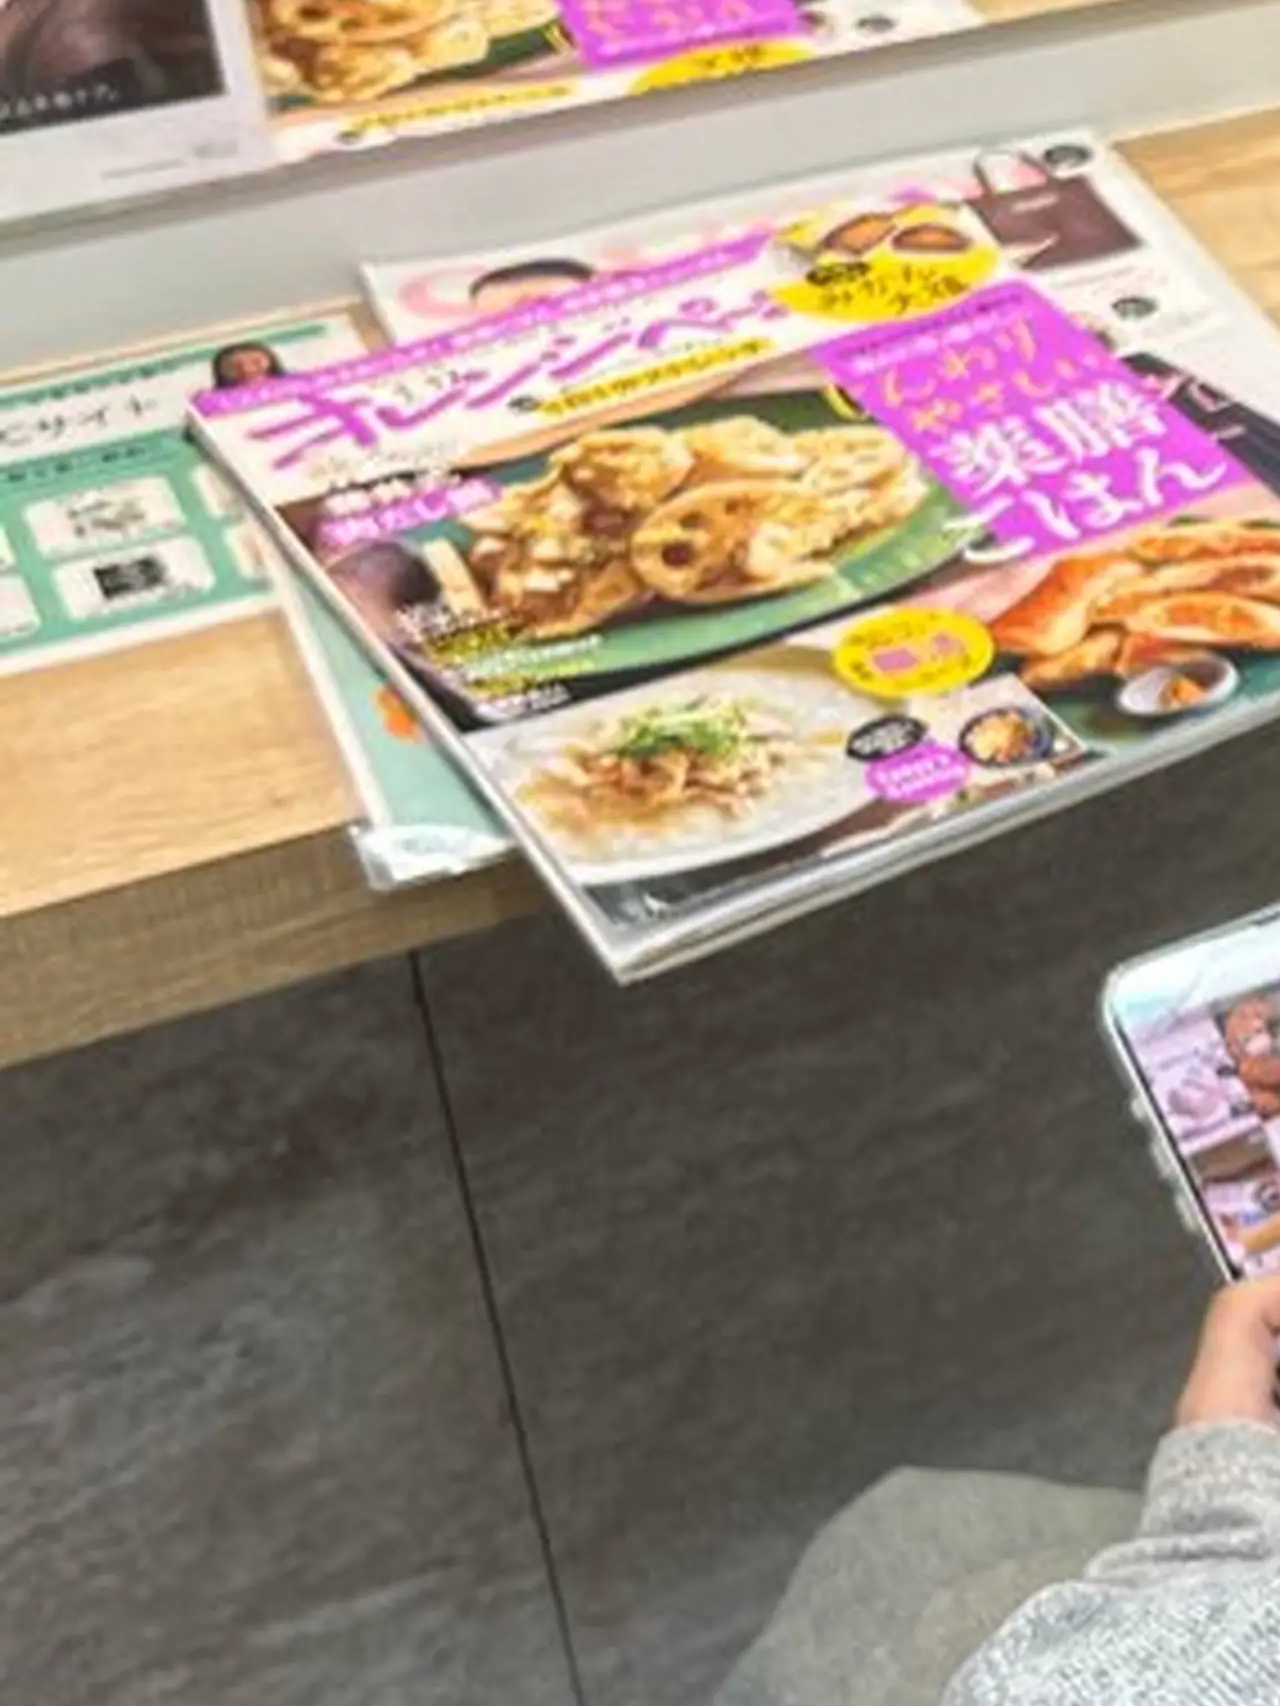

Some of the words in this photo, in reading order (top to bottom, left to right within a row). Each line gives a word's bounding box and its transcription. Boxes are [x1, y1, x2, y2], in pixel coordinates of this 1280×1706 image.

[928, 380, 1168, 495] 薬膳
[942, 447, 1228, 564] ごはん
